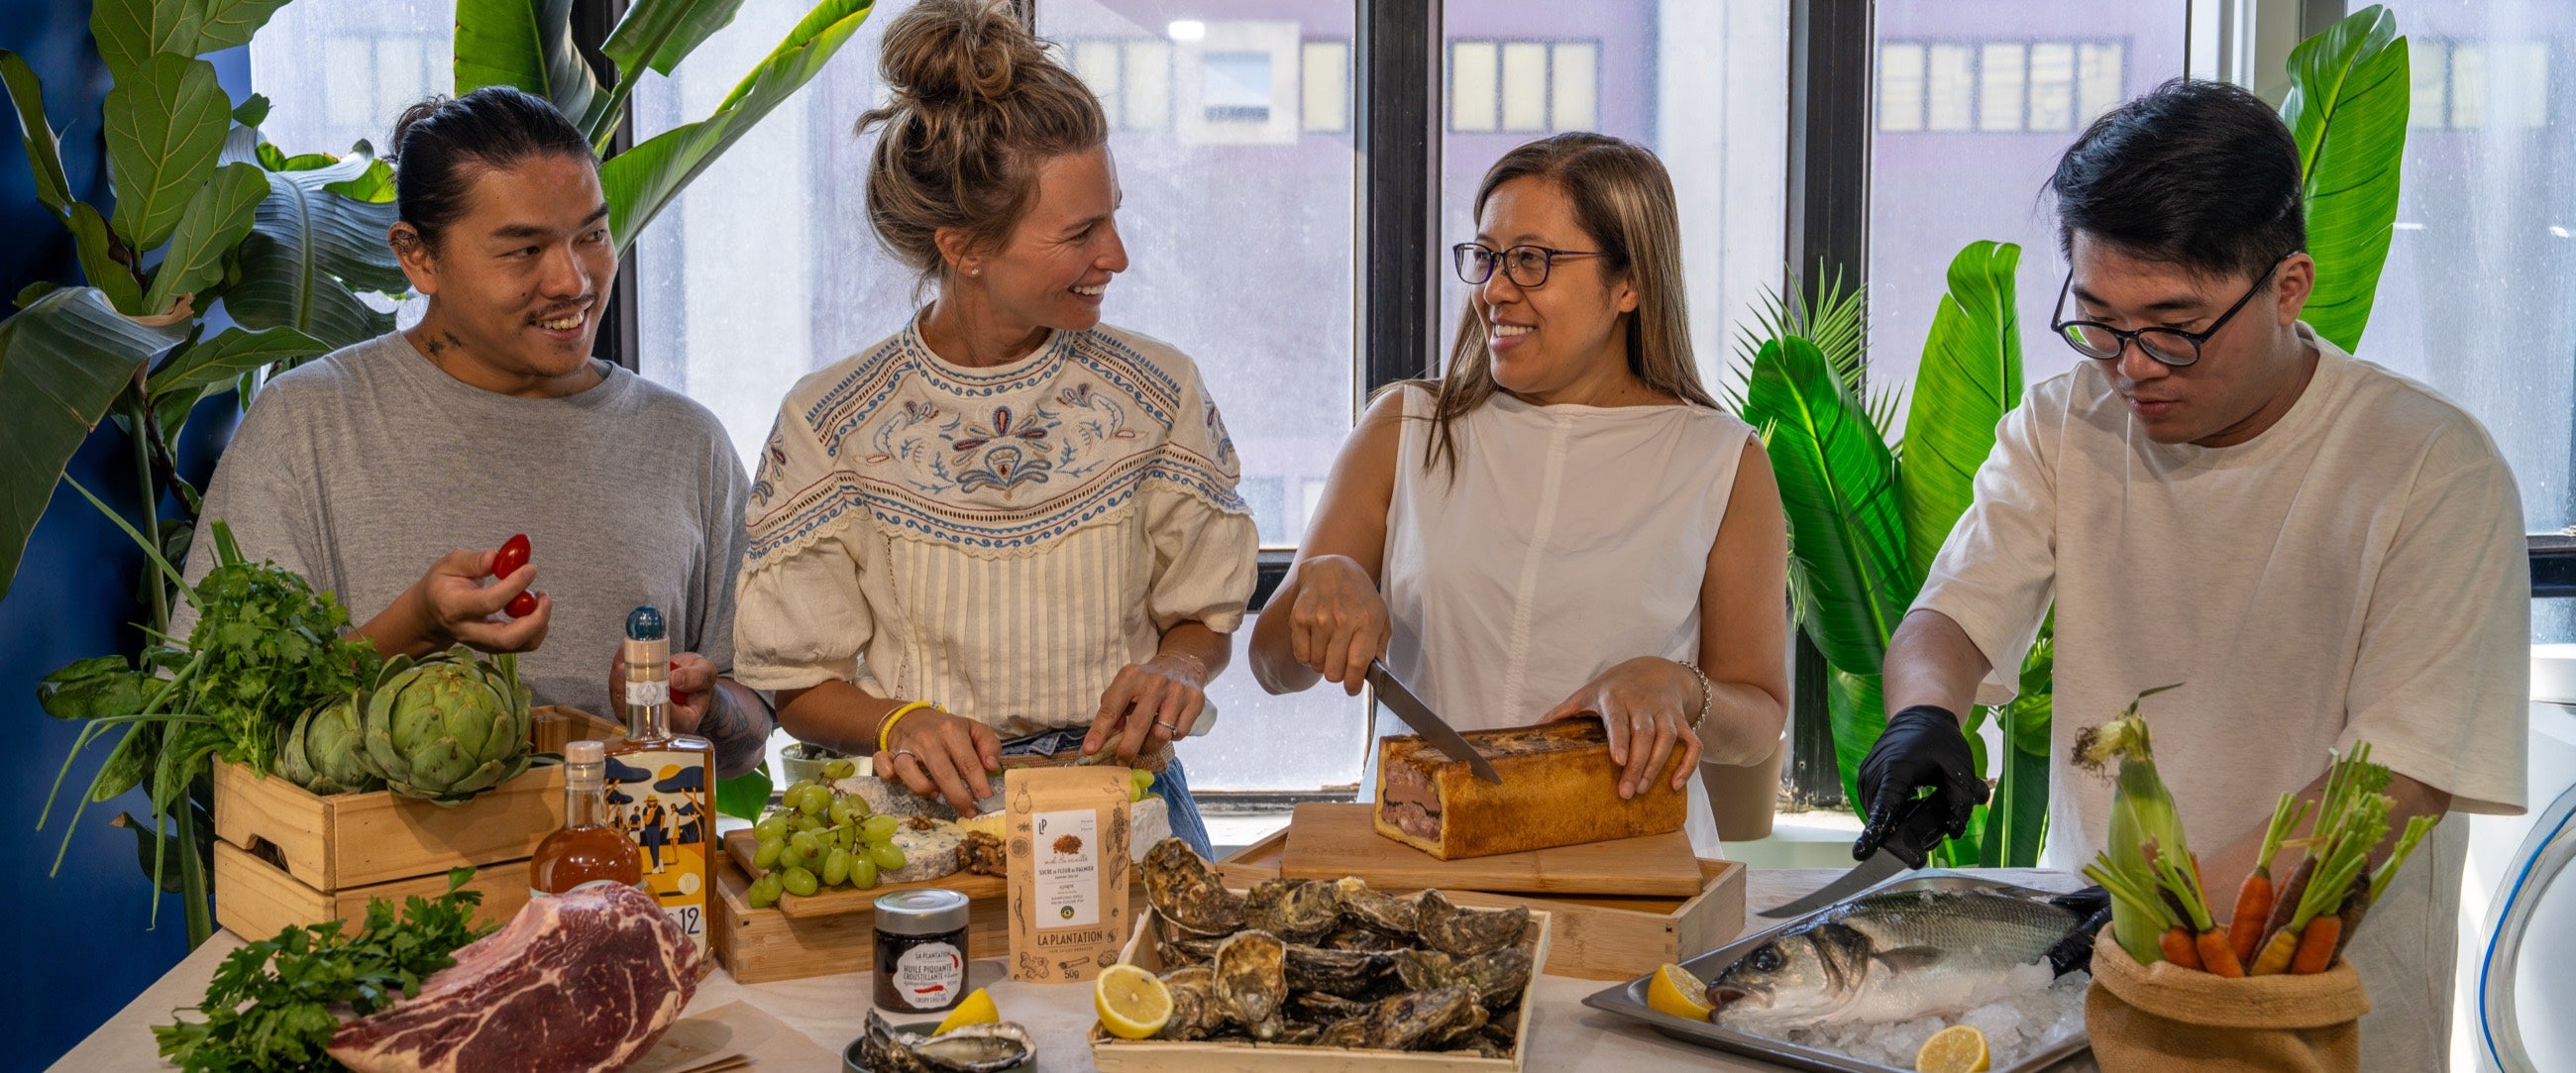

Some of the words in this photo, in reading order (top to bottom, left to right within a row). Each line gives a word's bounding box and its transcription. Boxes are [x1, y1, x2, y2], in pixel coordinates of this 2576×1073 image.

[679, 907, 700, 934] 12
[1037, 934, 1048, 946] LA
[1050, 929, 1103, 945] PLANTATION
[904, 964, 921, 973] HUILE
[923, 963, 952, 973] PIQUANTE
[904, 972, 943, 981] CROUSTILLANTE
[1064, 969, 1080, 979] 50g
